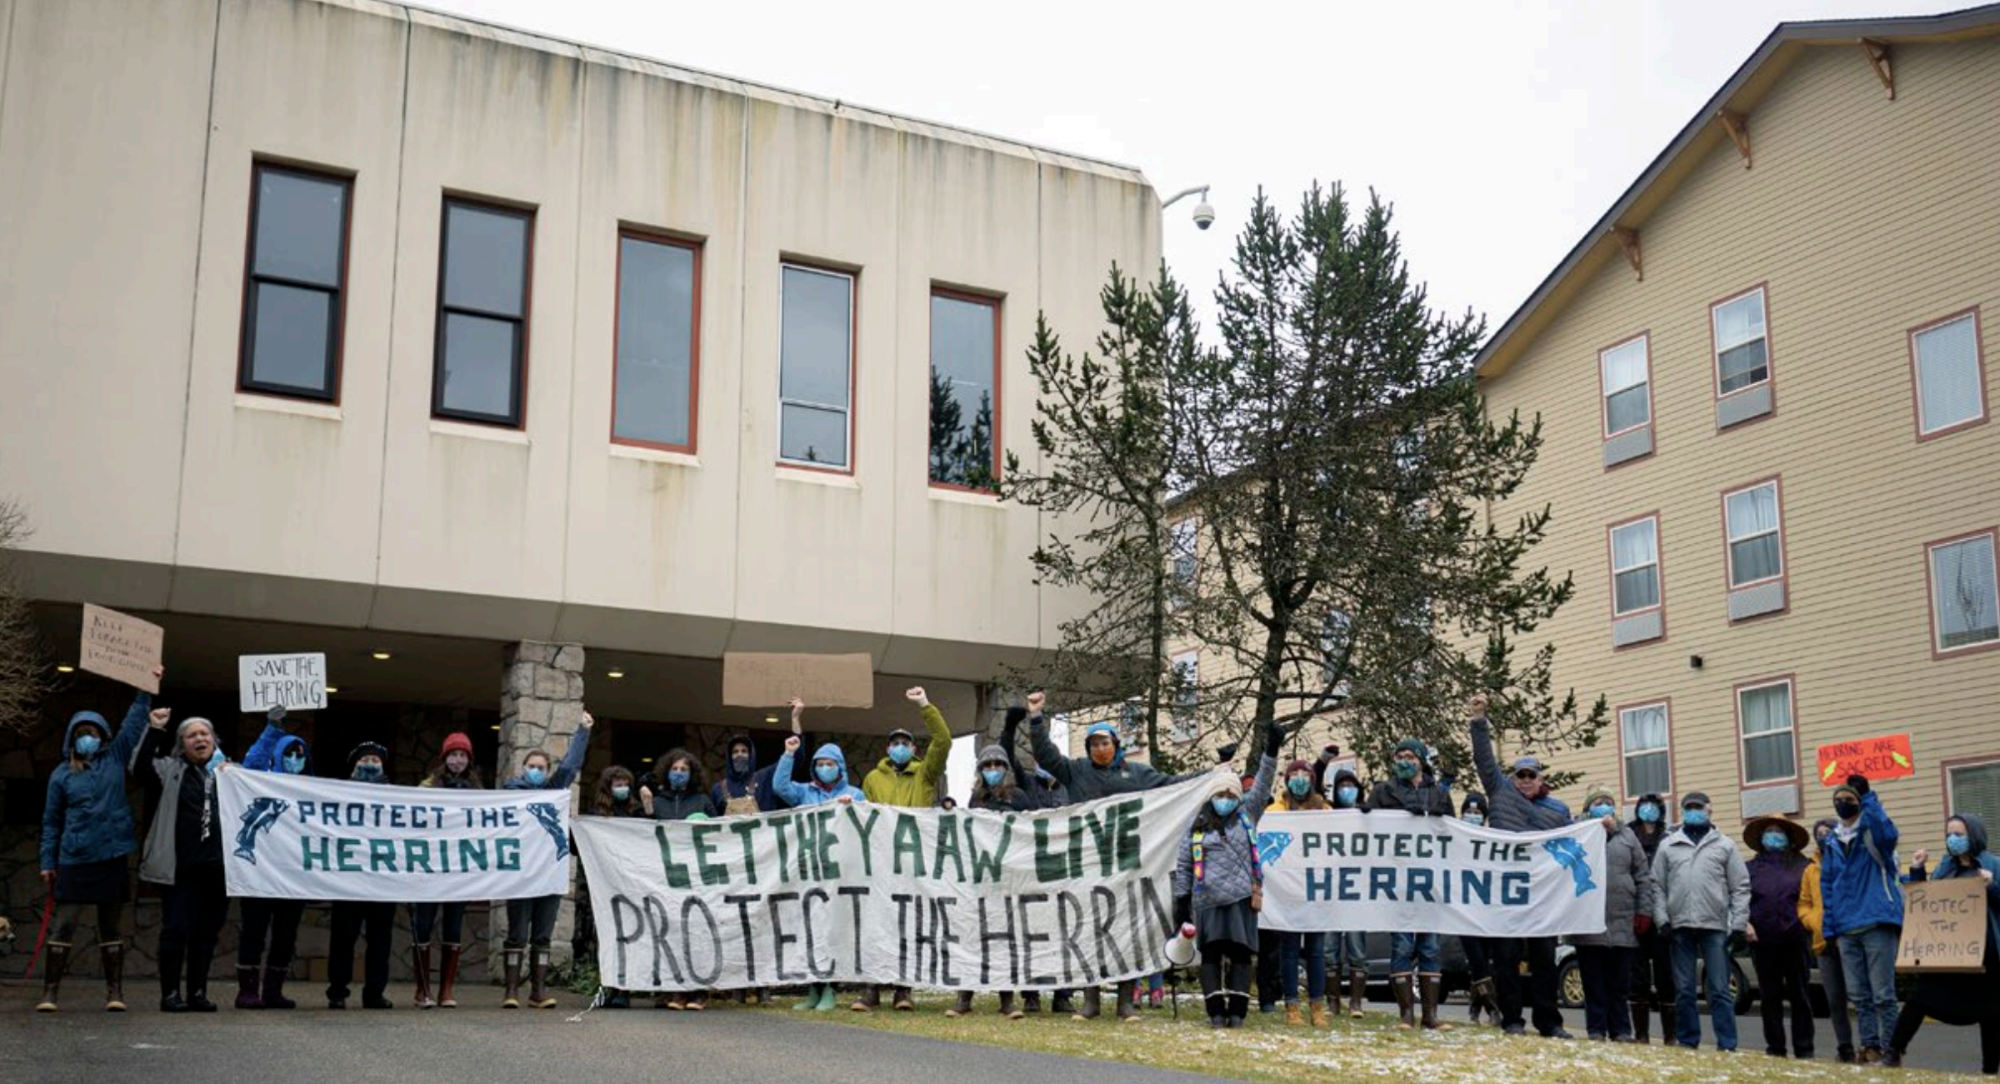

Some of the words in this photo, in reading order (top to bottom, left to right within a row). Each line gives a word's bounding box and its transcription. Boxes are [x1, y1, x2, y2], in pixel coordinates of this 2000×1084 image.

[254, 658, 292, 678] SAVE
[252, 679, 322, 709] HERRING
[1818, 742, 1864, 761] HERRING
[1873, 740, 1896, 754] ARE
[1836, 755, 1895, 779] SACRED
[297, 800, 445, 829] PROTECT
[461, 806, 520, 829] THE
[301, 835, 521, 873] HERRING
[655, 818, 761, 889] LET
[767, 809, 840, 884] THE
[845, 806, 1016, 884] YAAW
[1033, 798, 1143, 884] LIVE
[1302, 832, 1453, 859] PROTECT
[1469, 839, 1532, 863] THE
[1305, 867, 1531, 905] HERRING
[1909, 889, 1981, 914] PROTECT
[611, 886, 870, 987] PROTECT
[891, 894, 960, 986] THE
[978, 871, 1178, 985] HERRIN
[1930, 919, 1959, 933] THE
[1903, 939, 1981, 959] HERRING
